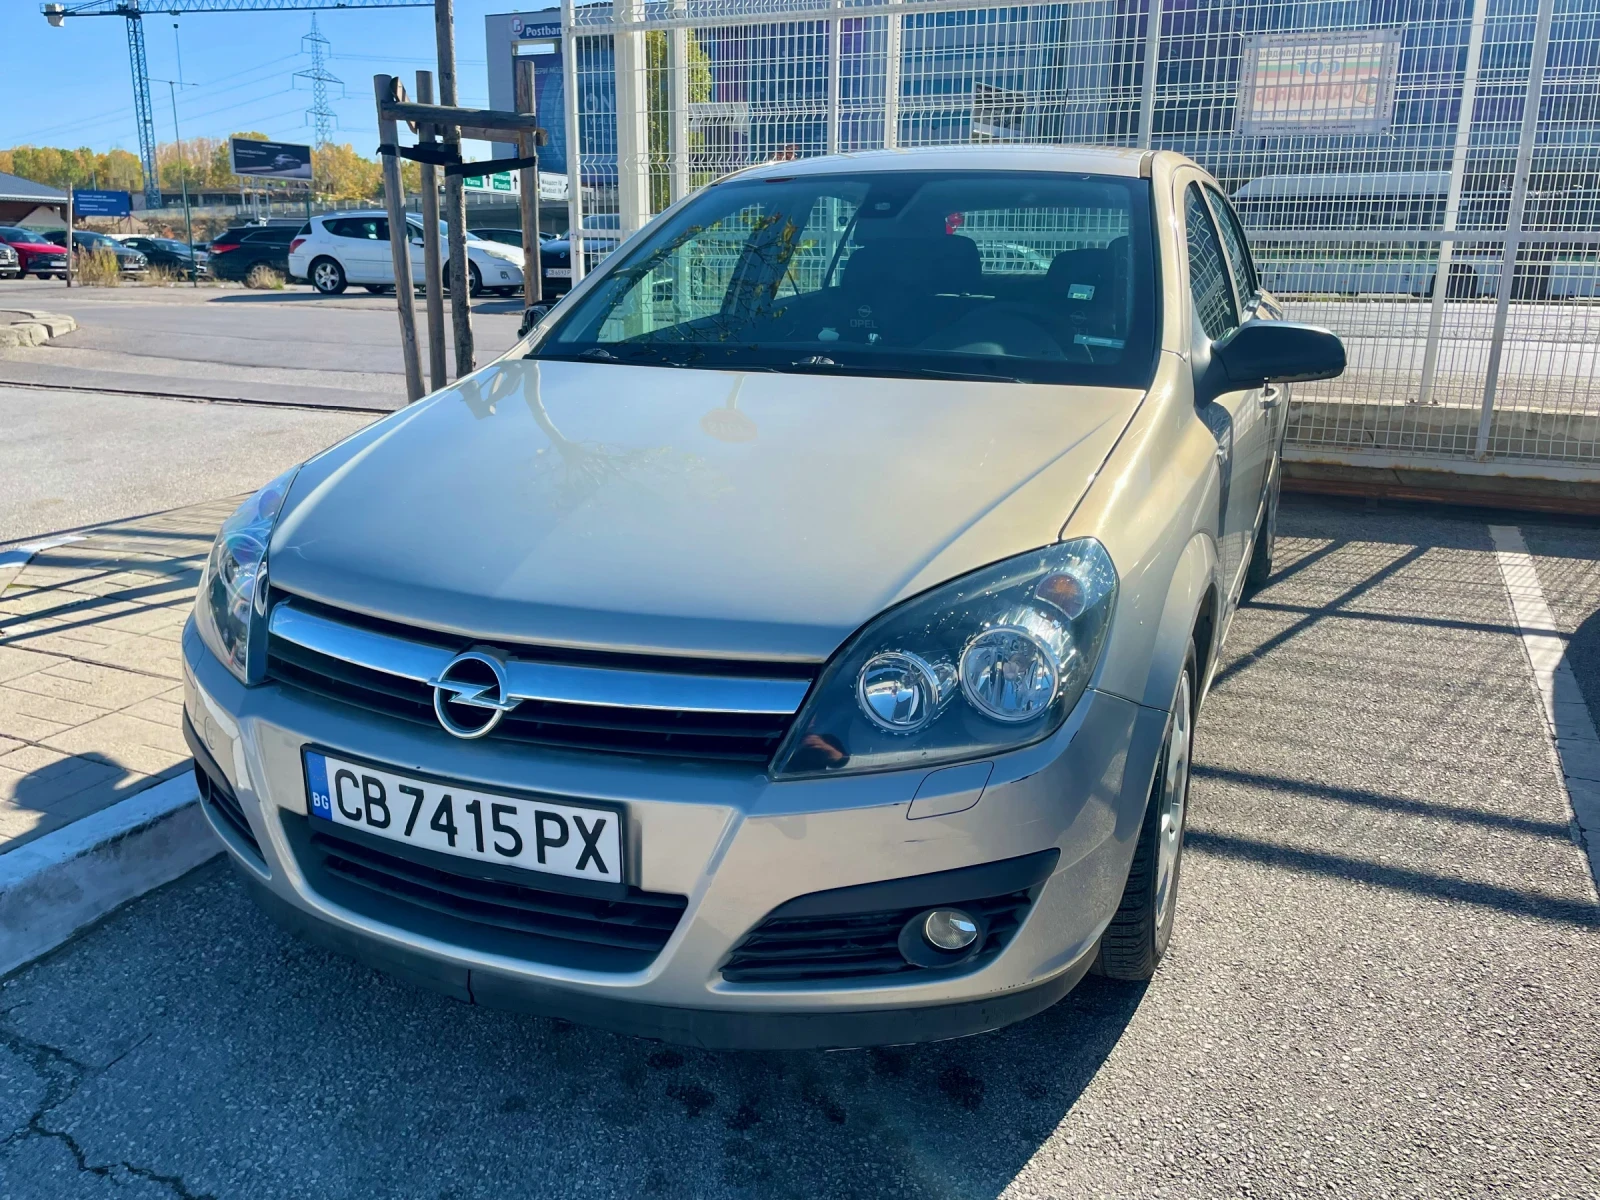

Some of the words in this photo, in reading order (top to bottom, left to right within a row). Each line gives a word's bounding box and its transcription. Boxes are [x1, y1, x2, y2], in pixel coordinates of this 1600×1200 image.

[526, 24, 562, 37] Postban
[588, 117, 617, 125] WALLE
[466, 177, 480, 186] Varna
[850, 319, 878, 328] OPEL
[312, 791, 330, 810] BG
